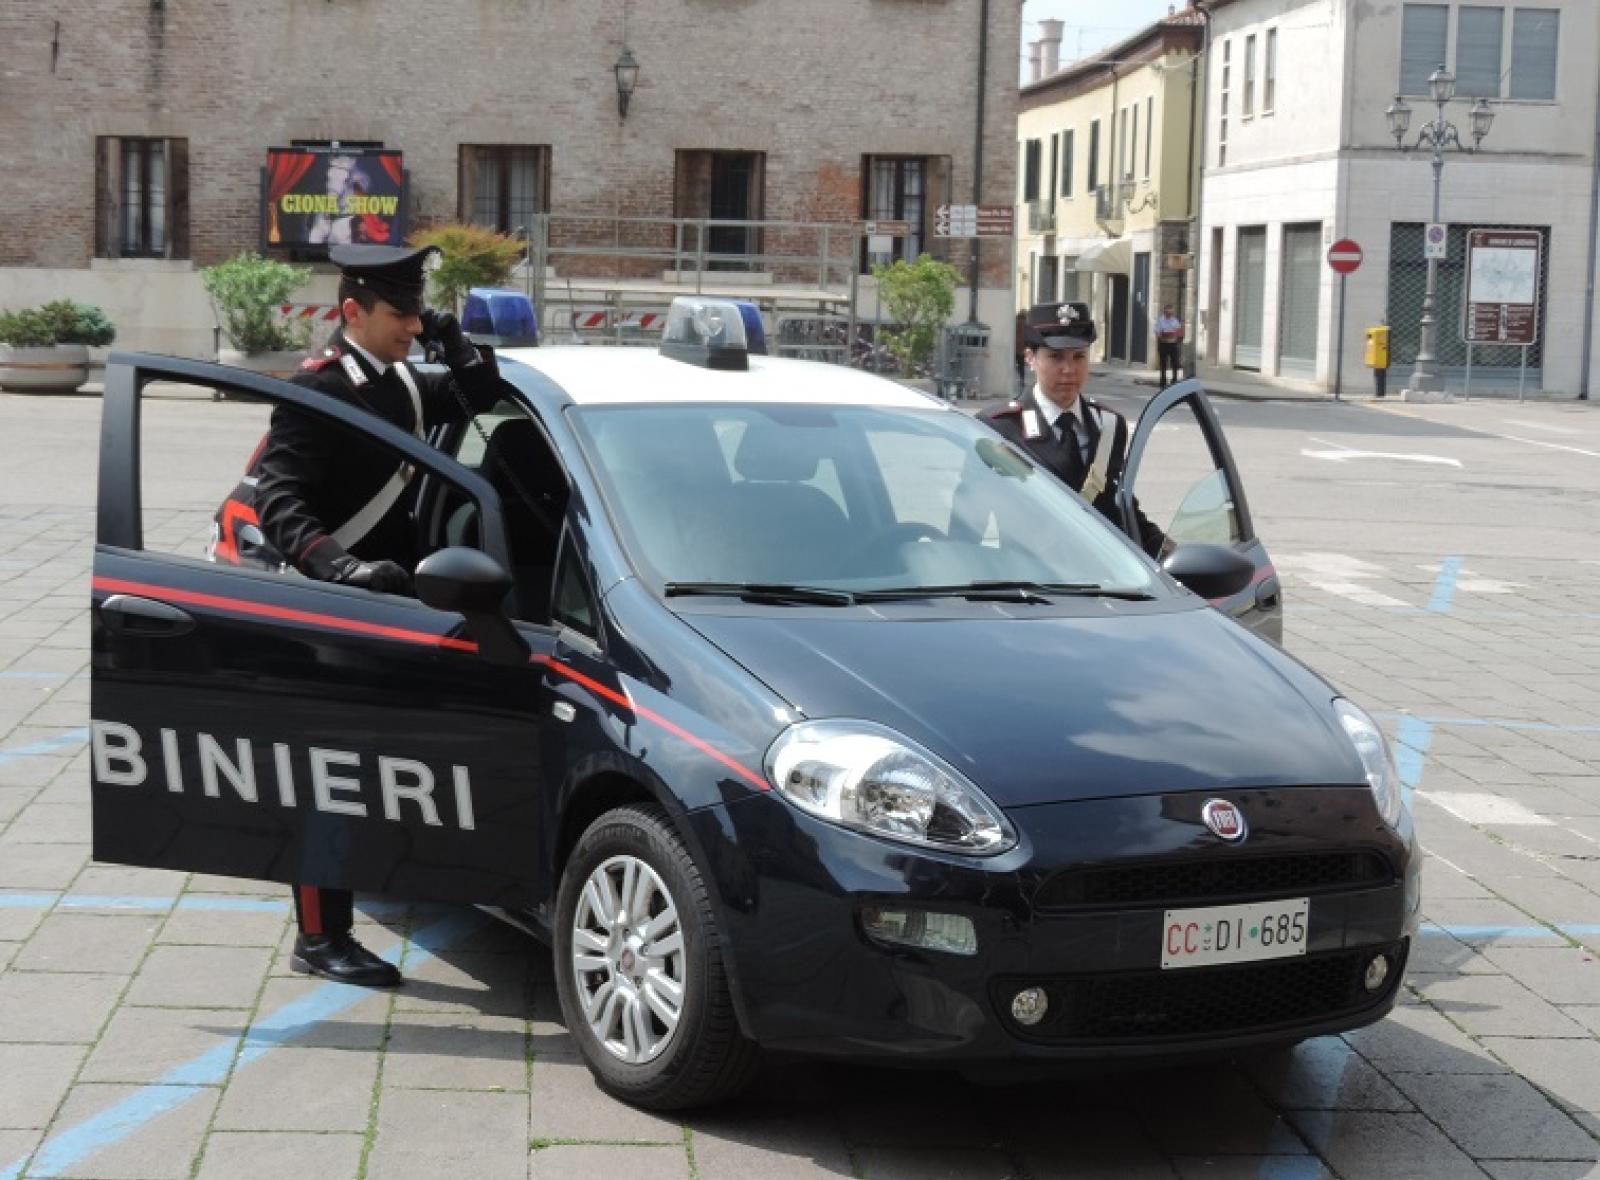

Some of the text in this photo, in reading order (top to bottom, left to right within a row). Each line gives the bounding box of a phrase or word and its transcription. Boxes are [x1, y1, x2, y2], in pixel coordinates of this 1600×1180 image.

[346, 195, 398, 217] SHOW
[92, 719, 475, 831] BINIERI
[1167, 911, 1306, 955] CC DI 685
